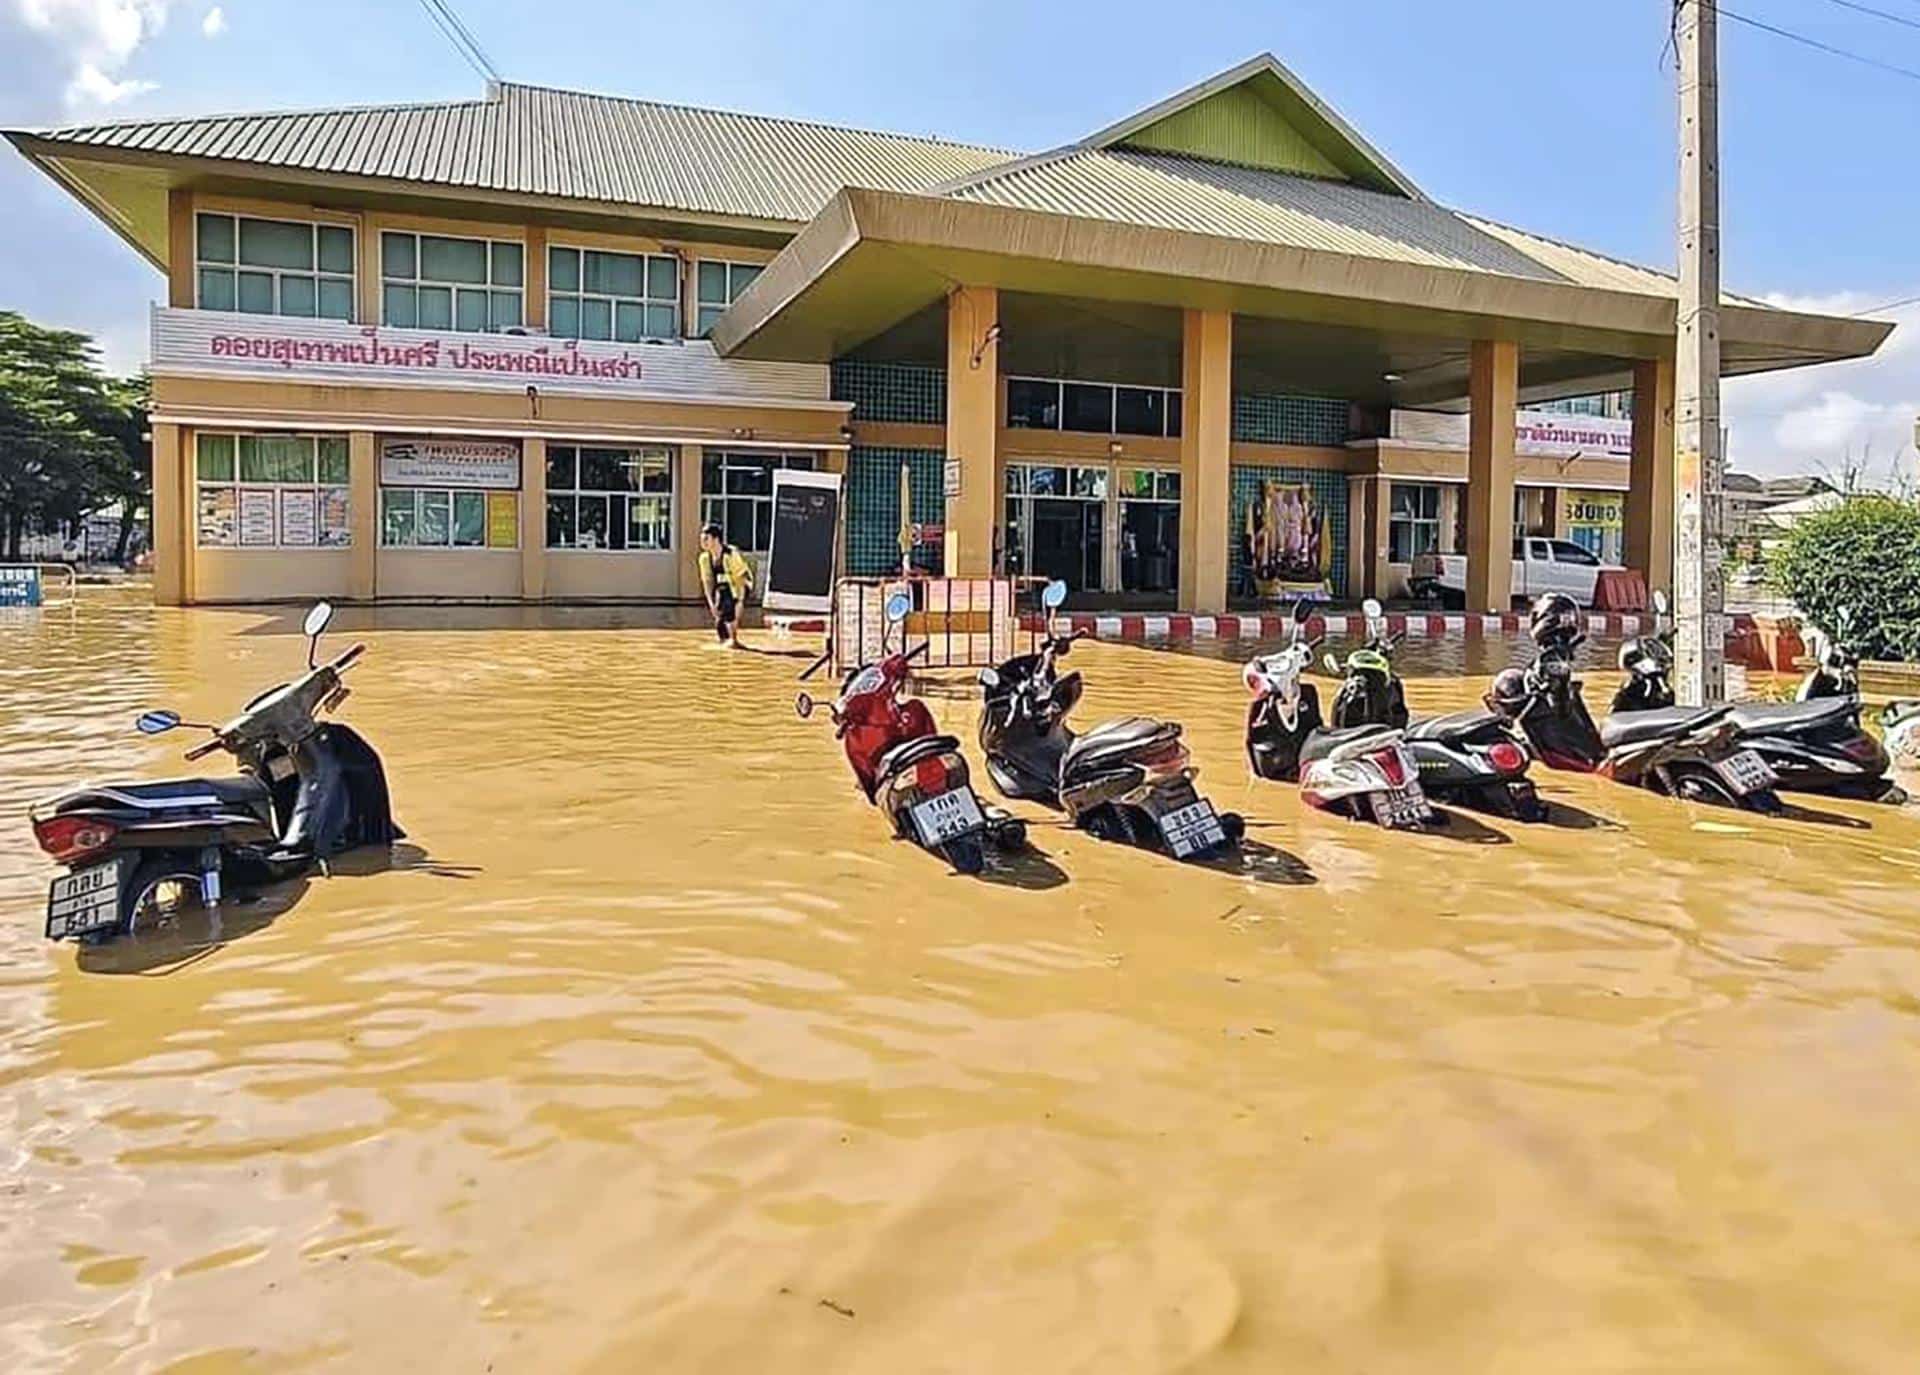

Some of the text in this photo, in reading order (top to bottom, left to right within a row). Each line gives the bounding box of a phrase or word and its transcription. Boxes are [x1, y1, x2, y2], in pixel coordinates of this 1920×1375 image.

[211, 327, 643, 379] ดอยสุเทพเป็นศรี ประเพณีเป็นสง่า
